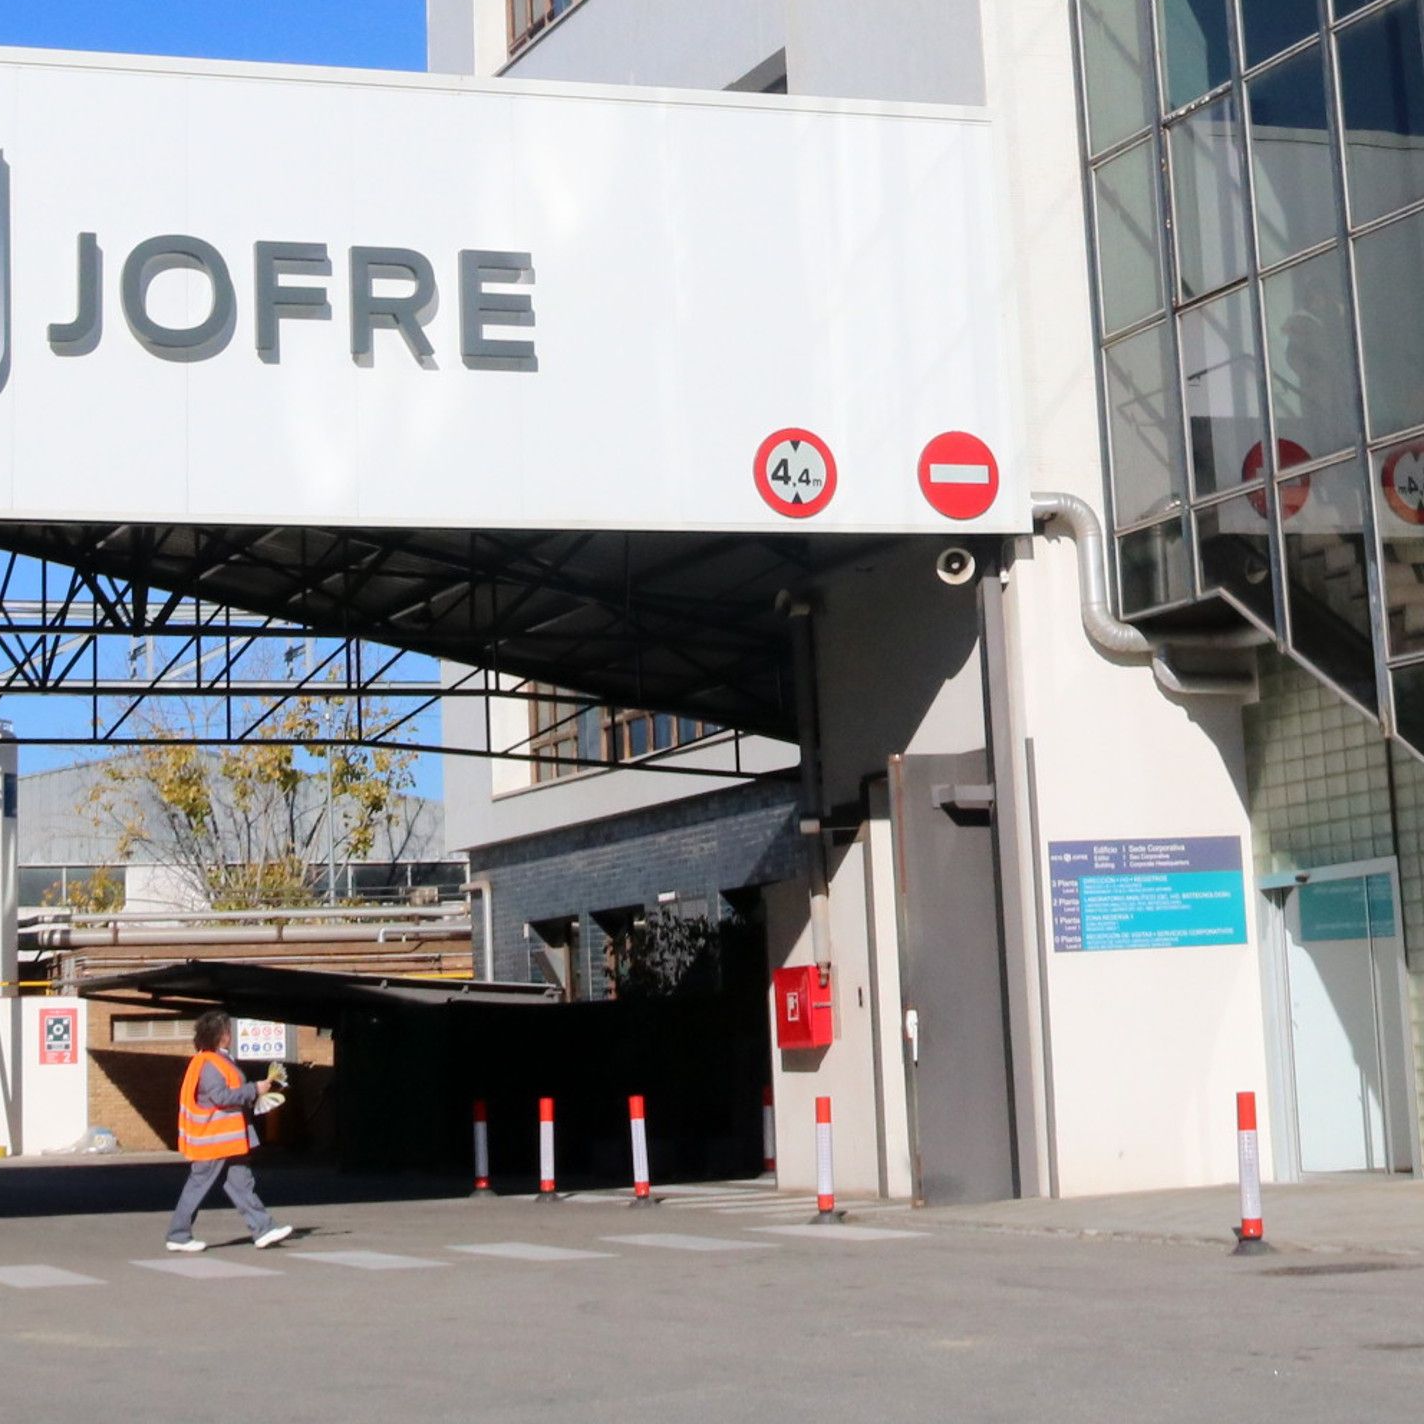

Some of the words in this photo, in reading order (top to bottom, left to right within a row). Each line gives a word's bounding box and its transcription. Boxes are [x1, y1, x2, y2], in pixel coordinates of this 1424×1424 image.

[48, 231, 537, 361] JOFRE
[1128, 844, 1146, 853] Sede
[1147, 843, 1185, 853] Corporativa
[1057, 879, 1078, 888] Planta
[1059, 898, 1080, 906] Planta
[1059, 917, 1080, 925] Planta
[1060, 935, 1081, 944] Planta
